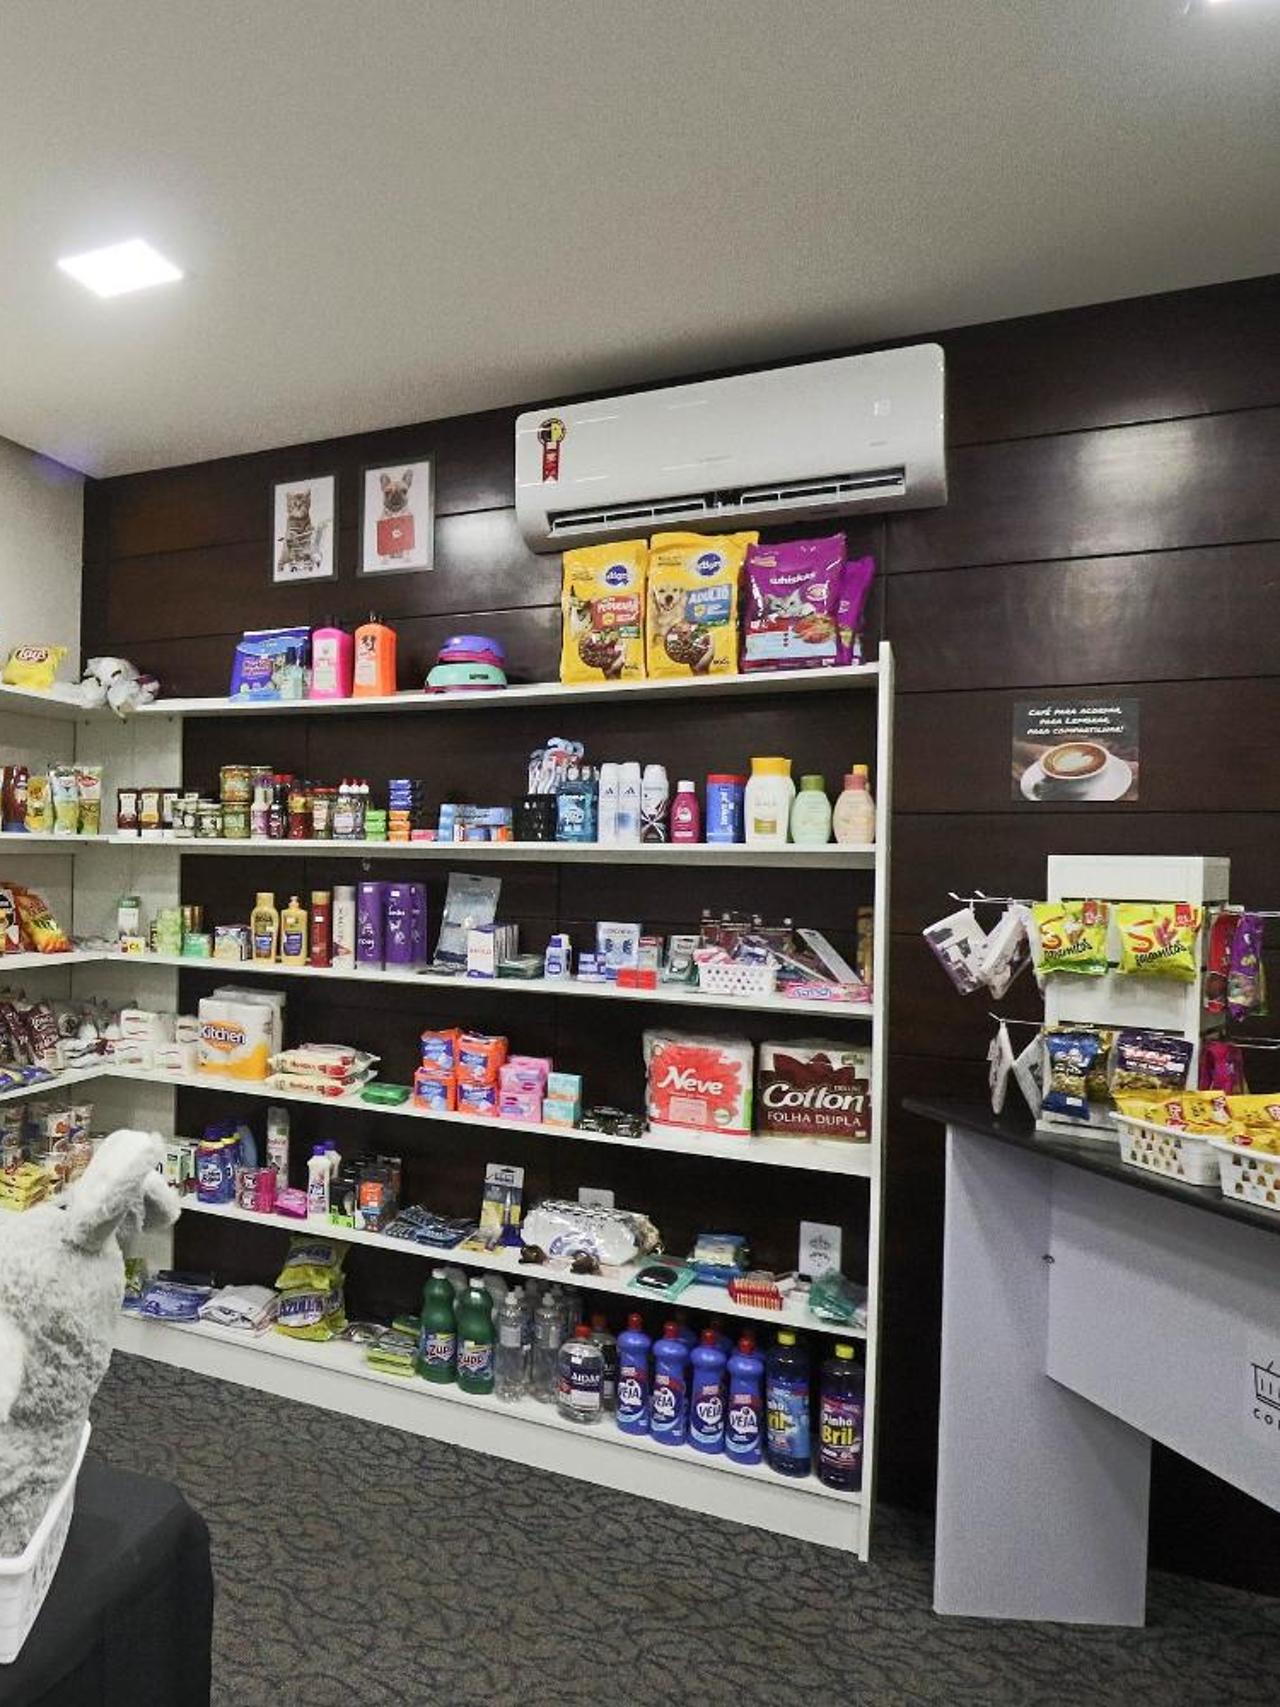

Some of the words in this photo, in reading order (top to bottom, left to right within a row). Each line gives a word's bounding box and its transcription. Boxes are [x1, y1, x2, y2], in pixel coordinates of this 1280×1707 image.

[198, 1025, 246, 1045] Kitchen
[658, 1066, 724, 1096] Neve
[762, 1083, 865, 1113] Cotton
[767, 1111, 811, 1123] FOLHA
[815, 1113, 862, 1127] DUPLA
[729, 1413, 758, 1427] VEJA
[1254, 1407, 1280, 1430] CO
[822, 1427, 854, 1445] Bril
